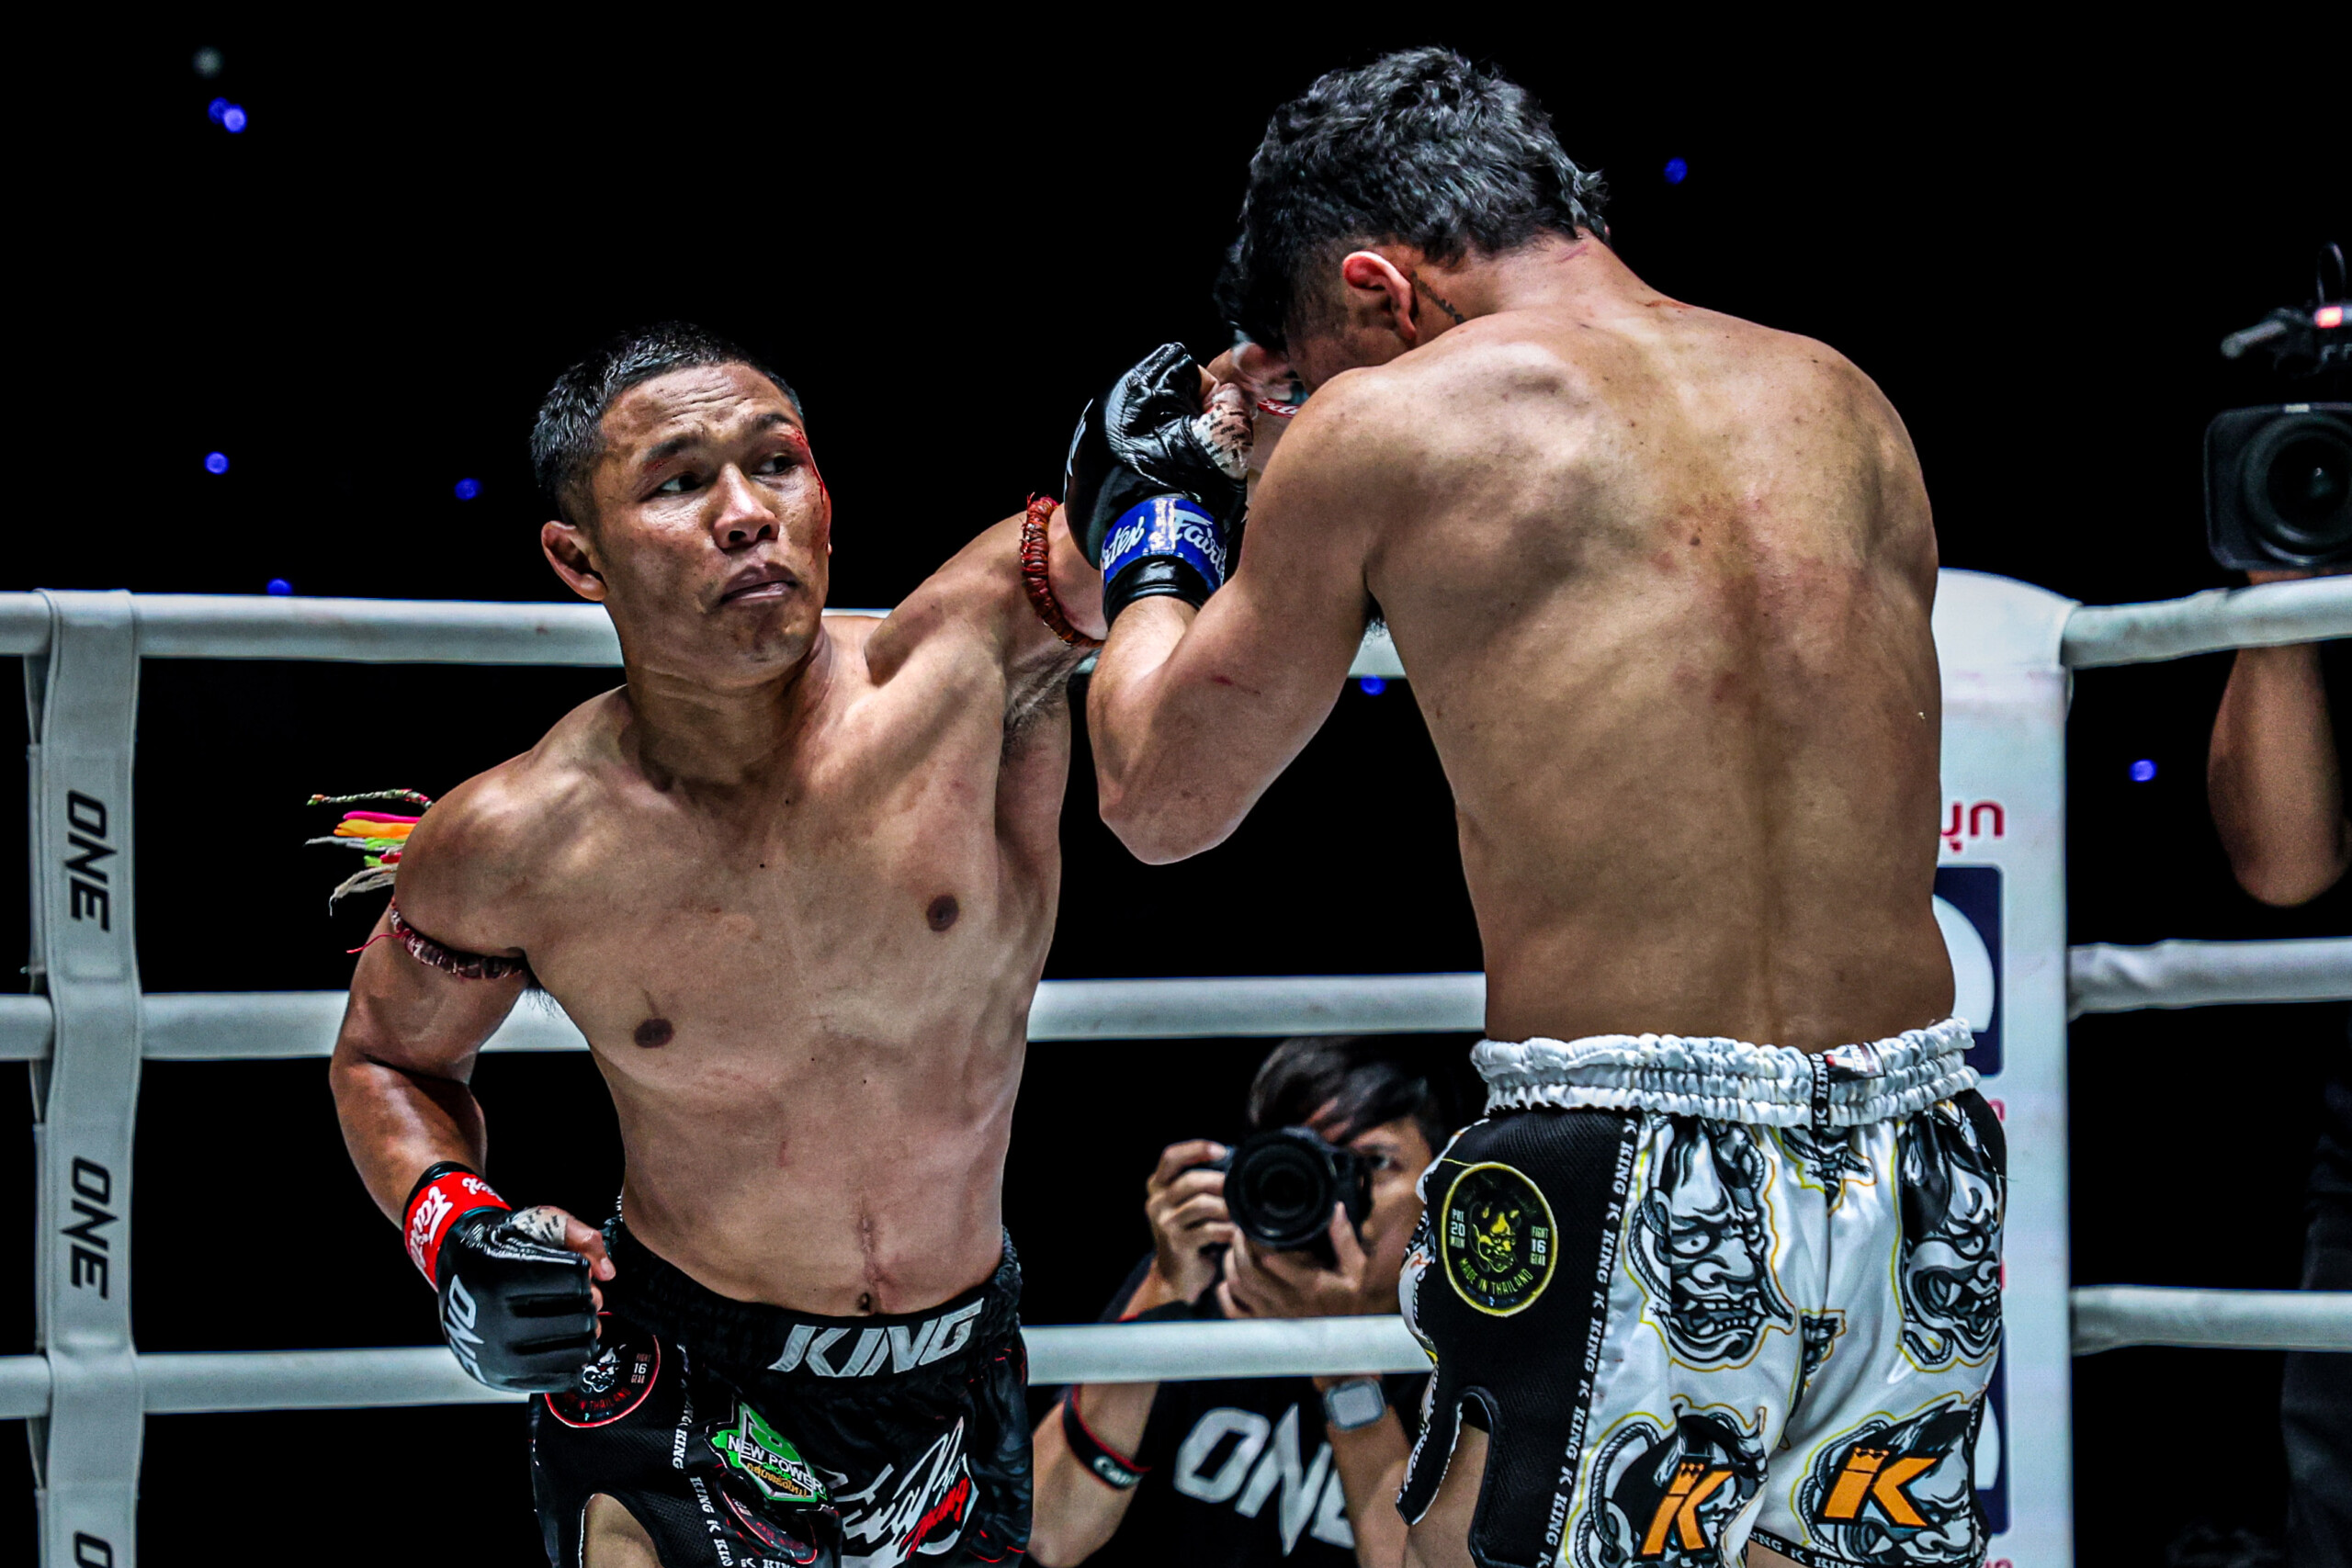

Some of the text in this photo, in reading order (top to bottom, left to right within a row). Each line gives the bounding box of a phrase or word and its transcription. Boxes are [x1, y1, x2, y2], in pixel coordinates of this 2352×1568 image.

[64, 789, 118, 932] ONE
[1612, 1140, 1634, 1195] KING
[61, 1156, 119, 1300] ONE
[1450, 1223, 1465, 1236] 20
[1531, 1239, 1546, 1253] 16
[1478, 1279, 1488, 1292] IN
[1491, 1269, 1534, 1296] THAILAND
[1596, 1229, 1616, 1284] KING
[768, 1297, 985, 1377] KING
[1584, 1317, 1603, 1373] KING
[633, 1362, 648, 1374] 16
[672, 1427, 687, 1470] KING
[1565, 1404, 1587, 1461] KING
[728, 1434, 825, 1495] NEW POWER
[690, 1476, 715, 1514] KING
[1544, 1492, 1568, 1547] KING
[1749, 1531, 1783, 1552] ING
